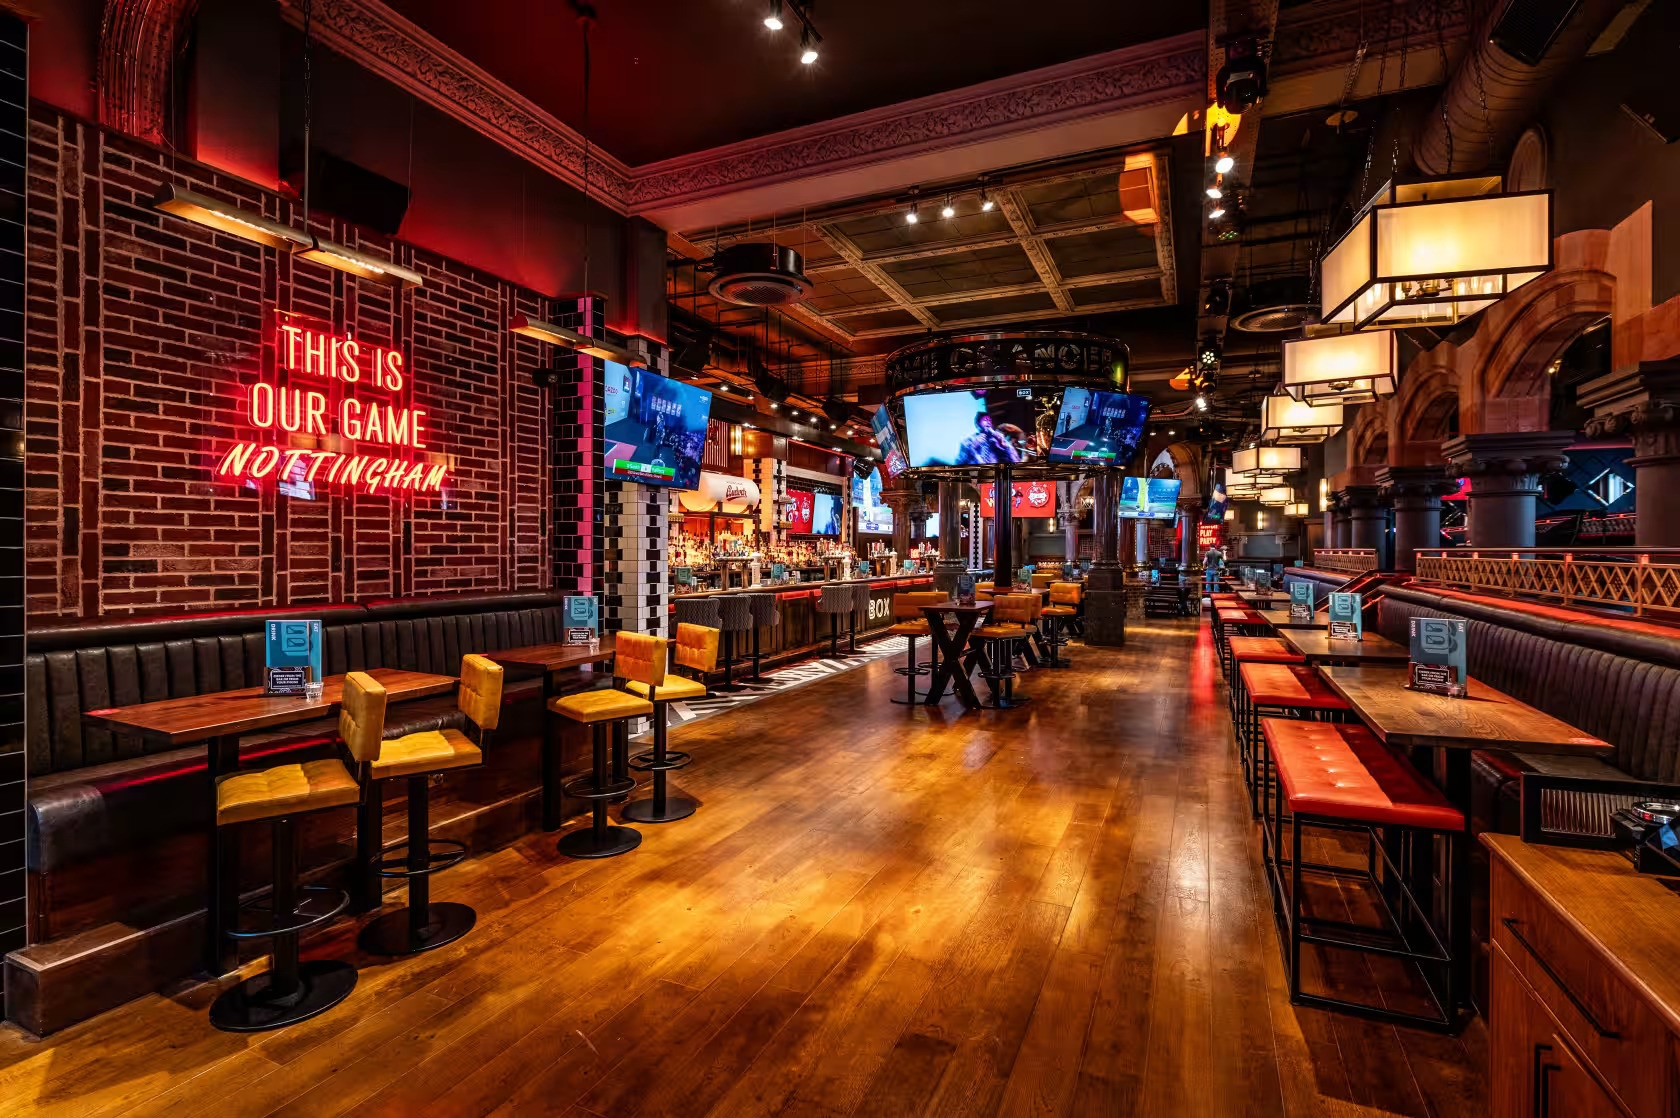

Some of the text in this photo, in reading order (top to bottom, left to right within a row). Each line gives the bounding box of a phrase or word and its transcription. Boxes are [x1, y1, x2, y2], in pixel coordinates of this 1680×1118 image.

[281, 324, 402, 391] THIS IS
[251, 382, 427, 449] OUR GAME
[219, 442, 447, 494] NOTTINGHAM
[1199, 529, 1213, 537] PLAY
[868, 597, 890, 620] BOX
